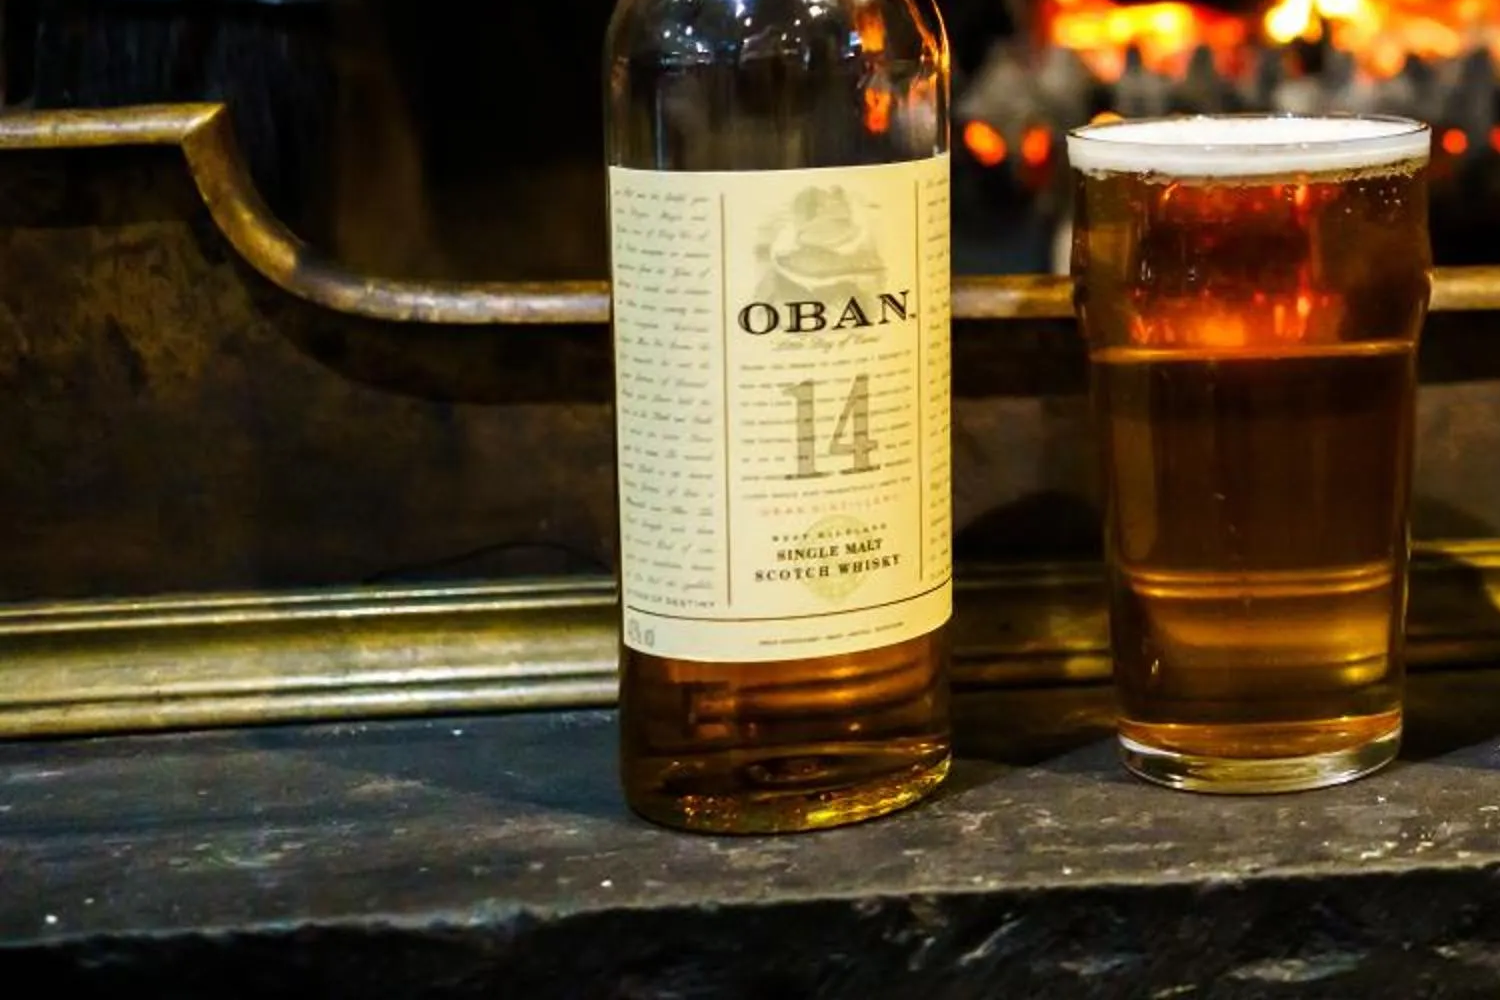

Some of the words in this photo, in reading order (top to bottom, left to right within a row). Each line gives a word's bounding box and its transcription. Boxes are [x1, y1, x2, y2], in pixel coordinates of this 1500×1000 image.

[737, 290, 910, 335] OBAN
[780, 373, 881, 480] 14
[777, 545, 839, 561] SINGLE
[845, 538, 883, 555] MALT
[754, 565, 830, 582] SCOTCH
[838, 554, 901, 575] WHISKY
